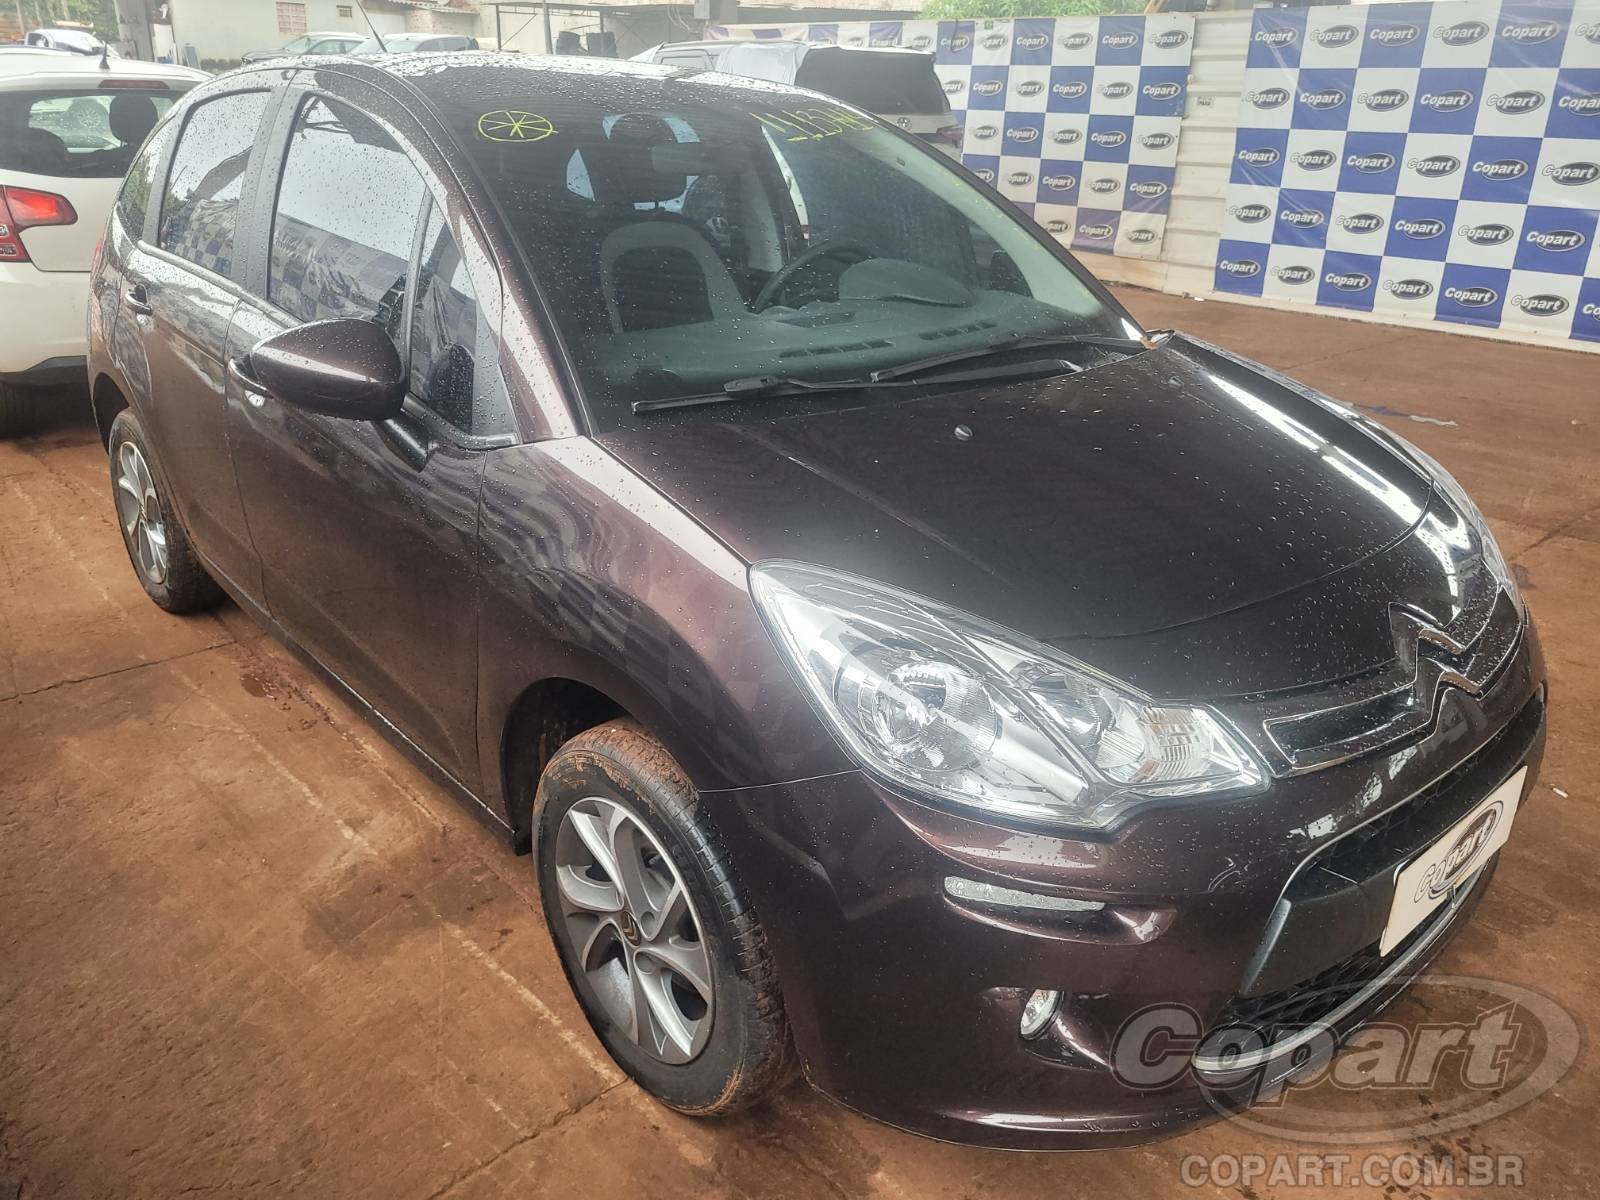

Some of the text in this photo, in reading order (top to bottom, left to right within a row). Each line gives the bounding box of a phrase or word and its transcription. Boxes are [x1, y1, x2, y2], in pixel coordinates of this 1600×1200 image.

[1255, 28, 1294, 44] Copart
[1309, 28, 1351, 44] Copart
[1370, 26, 1414, 42] Copart
[1433, 24, 1481, 41] Copart
[1502, 22, 1552, 41] Copart
[1574, 24, 1600, 41] Cop
[1016, 34, 1047, 47] Copart
[1102, 32, 1137, 48] Copart
[973, 79, 999, 94] Copart
[1052, 82, 1083, 96] Copart
[1142, 83, 1177, 97] Copart
[1246, 90, 1284, 106] Copart
[1300, 91, 1341, 107] Copart
[1357, 91, 1401, 108] Copart
[1420, 93, 1467, 109] Copart
[1486, 93, 1536, 109] Copart
[1558, 94, 1600, 111] Copar
[1007, 128, 1036, 140] Copart
[1091, 131, 1122, 145] Copart
[1238, 149, 1275, 165] Copart
[1290, 151, 1330, 167] Copart
[1347, 154, 1389, 170] Copart
[1406, 157, 1452, 173] Copart
[1472, 160, 1522, 176] Copart
[1541, 163, 1594, 180] Copart
[1042, 174, 1073, 188] Copart
[1130, 181, 1162, 196] Copart
[1229, 204, 1266, 220] Copart
[1280, 209, 1320, 226] Copart
[1079, 223, 1112, 238] Copart
[1335, 214, 1377, 231] Copart
[1395, 218, 1439, 237] Copart
[1458, 224, 1507, 242] Copart
[1526, 230, 1577, 248] Copart
[1220, 259, 1257, 275] Copart
[1270, 265, 1310, 282] Copart
[1325, 272, 1366, 289] Copart
[1383, 278, 1426, 295] Copart
[1444, 286, 1492, 304] Copart
[1511, 294, 1560, 312] Copart
